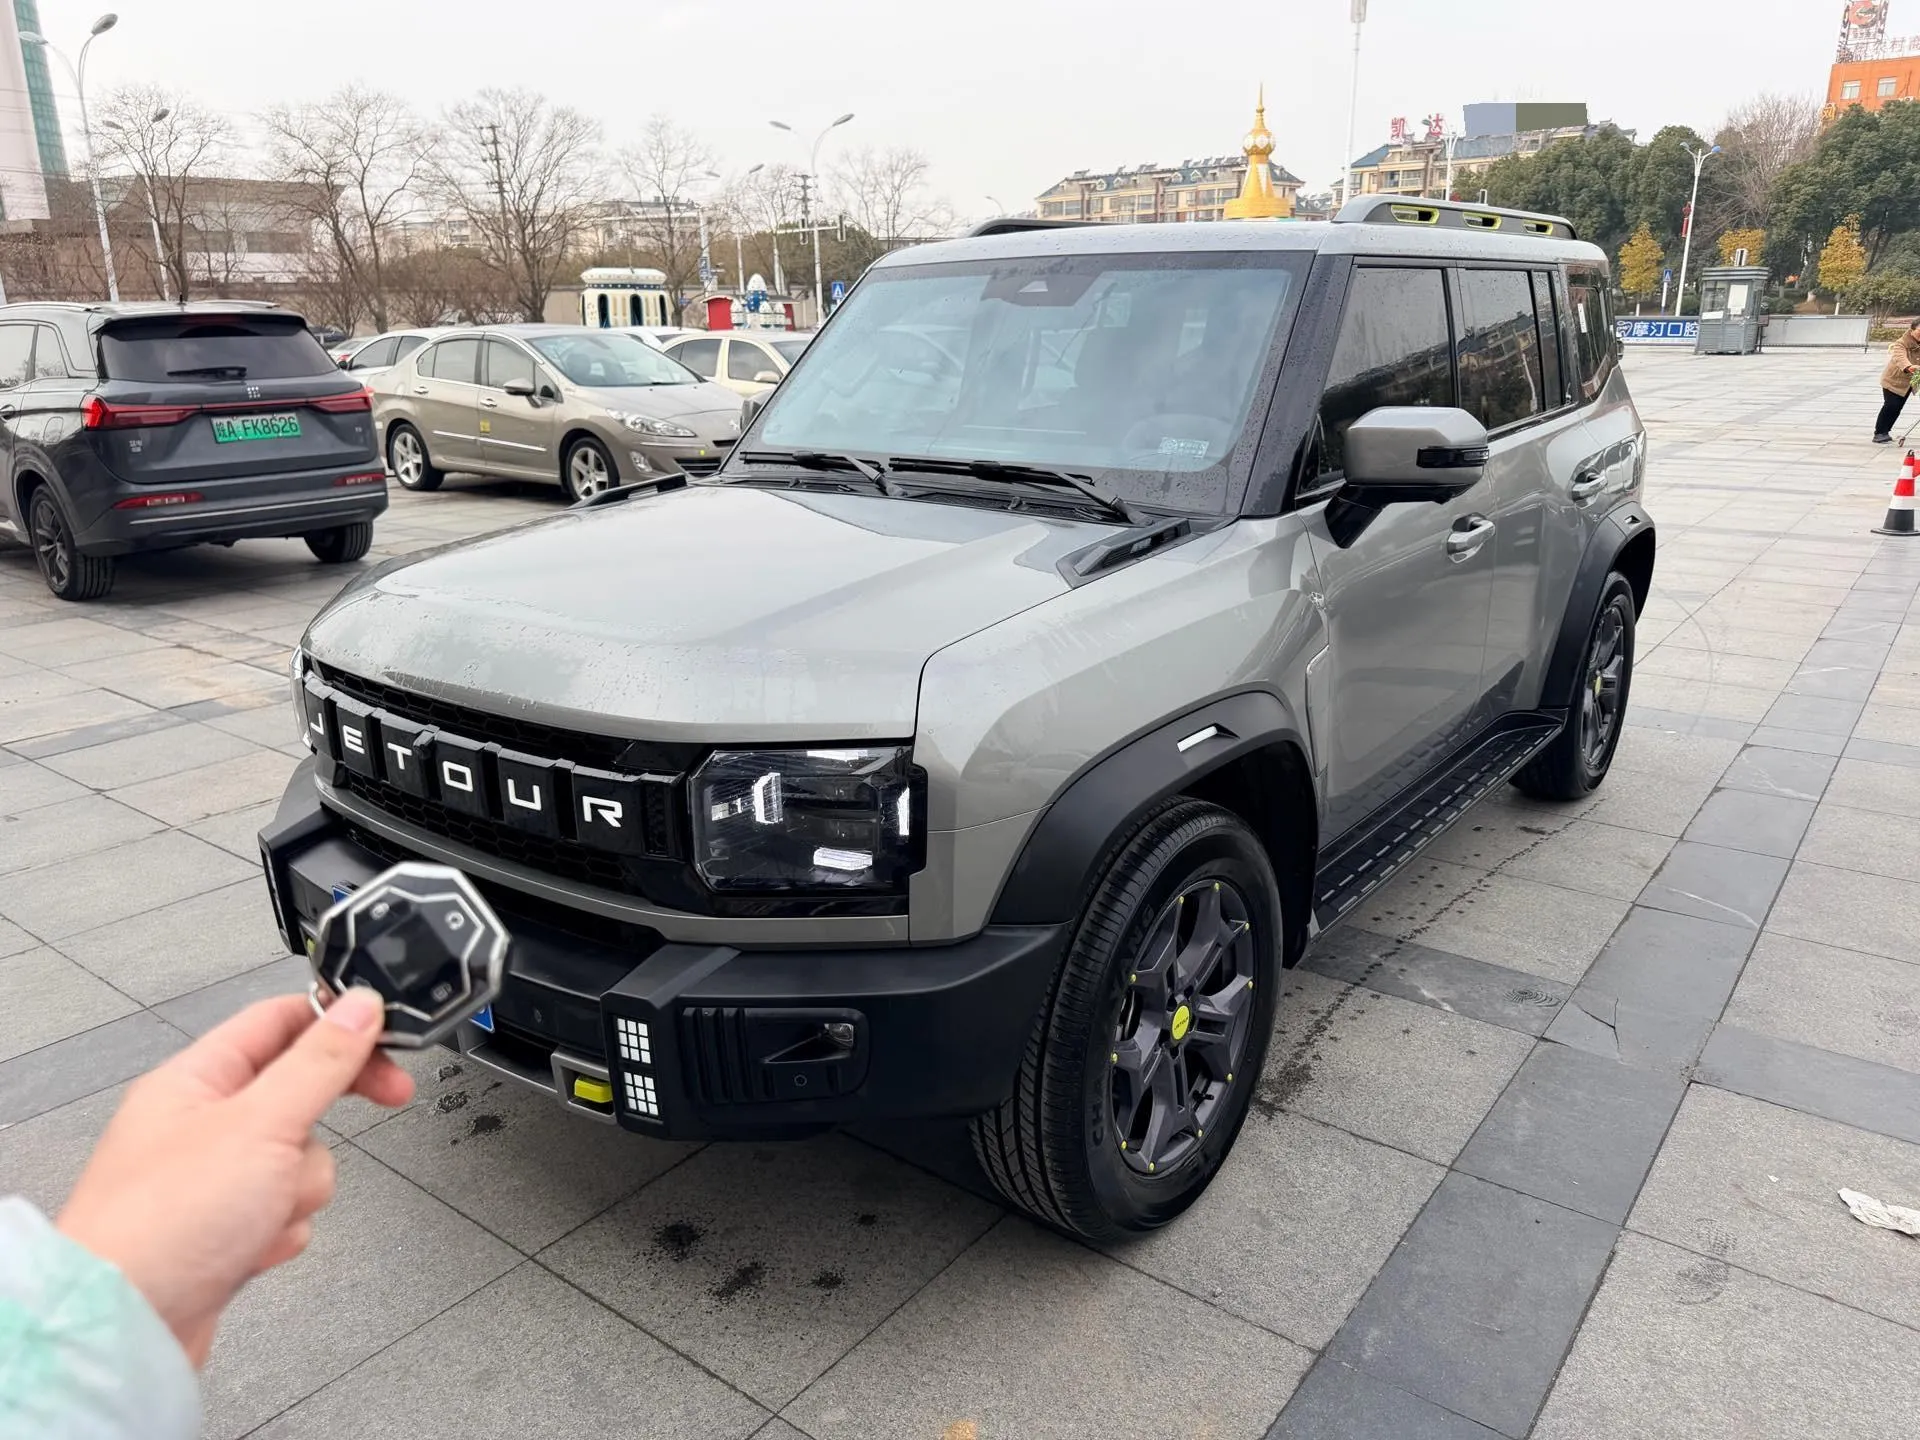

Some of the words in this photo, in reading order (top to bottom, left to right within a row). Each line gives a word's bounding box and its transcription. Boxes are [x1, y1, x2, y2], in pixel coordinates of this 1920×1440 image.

[1632, 321, 1699, 337] 摩汀口腔
[309, 713, 623, 828] JETOUR
